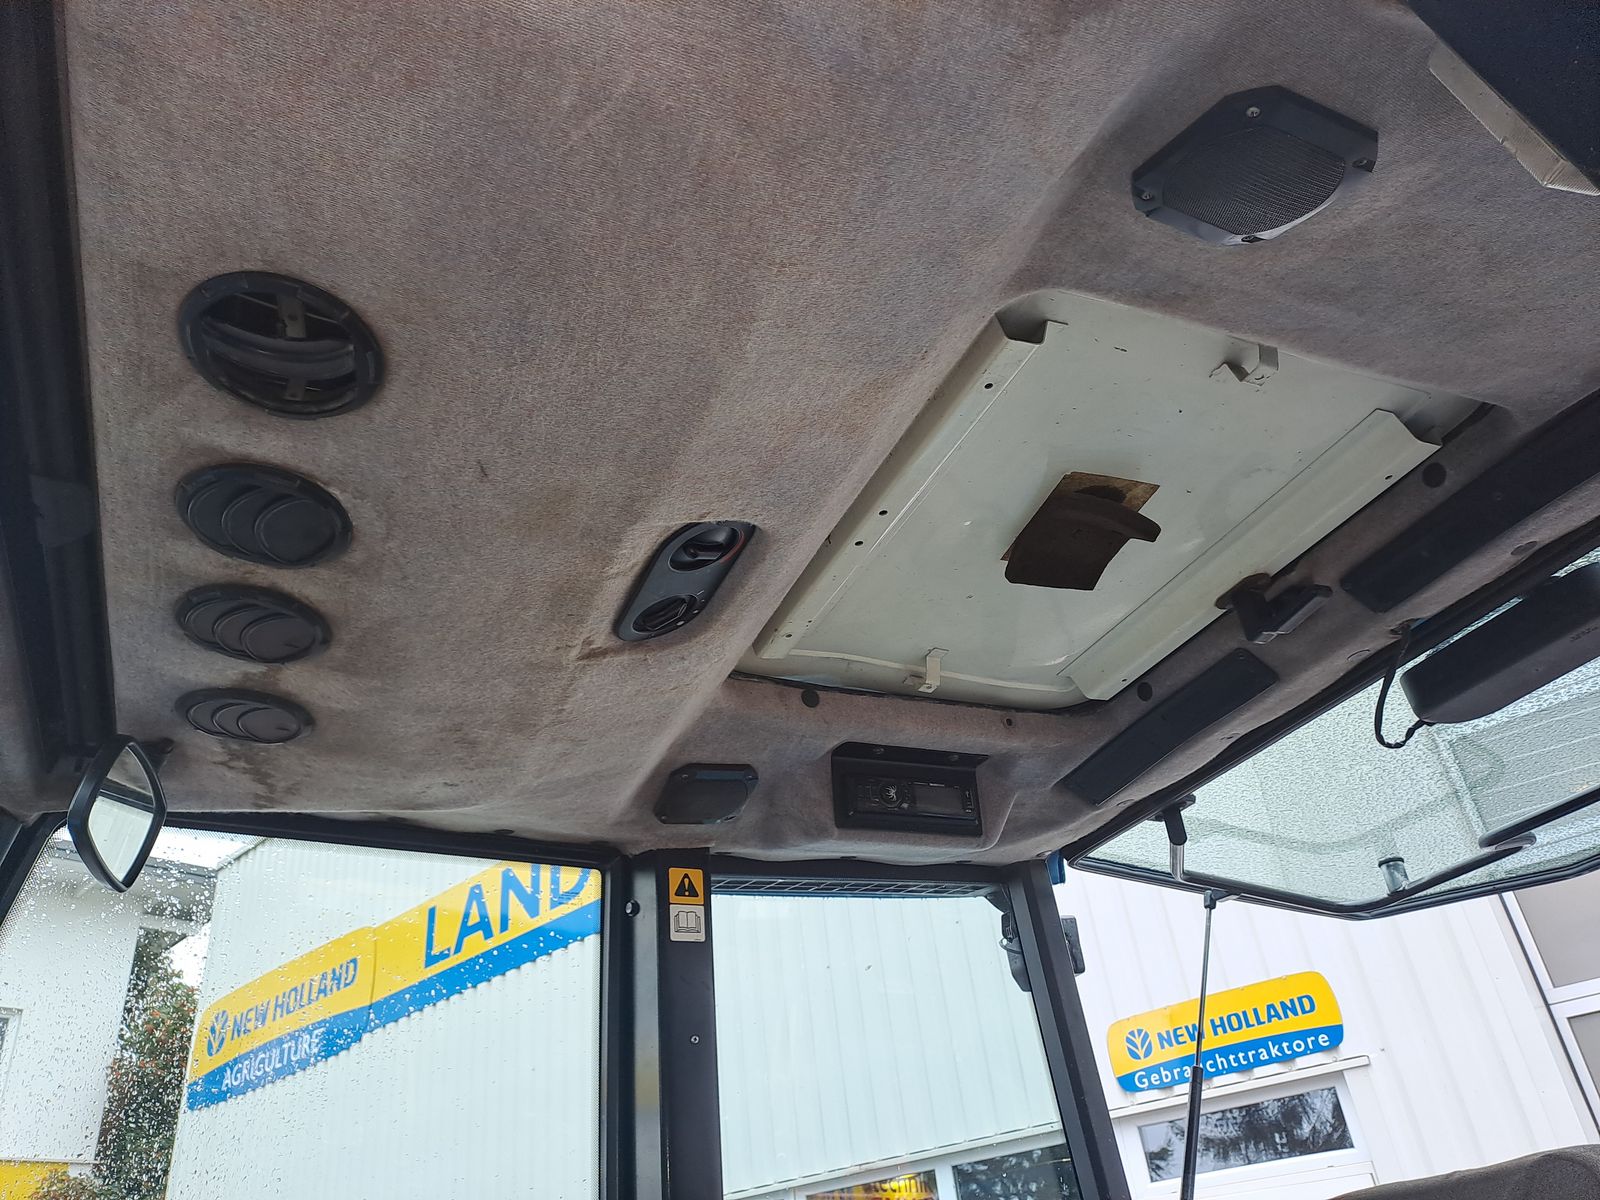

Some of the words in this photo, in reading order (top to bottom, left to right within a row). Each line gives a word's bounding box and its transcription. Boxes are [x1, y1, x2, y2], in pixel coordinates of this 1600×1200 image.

[424, 864, 592, 969] LAND
[230, 999, 271, 1041] NEW
[272, 957, 359, 1022] HOLLAND
[1157, 1023, 1206, 1050] NEW
[1209, 994, 1317, 1036] HOLLAND
[221, 1027, 327, 1091] AGRICULTURE
[1134, 1033, 1331, 1088] Gebrachttraktore
